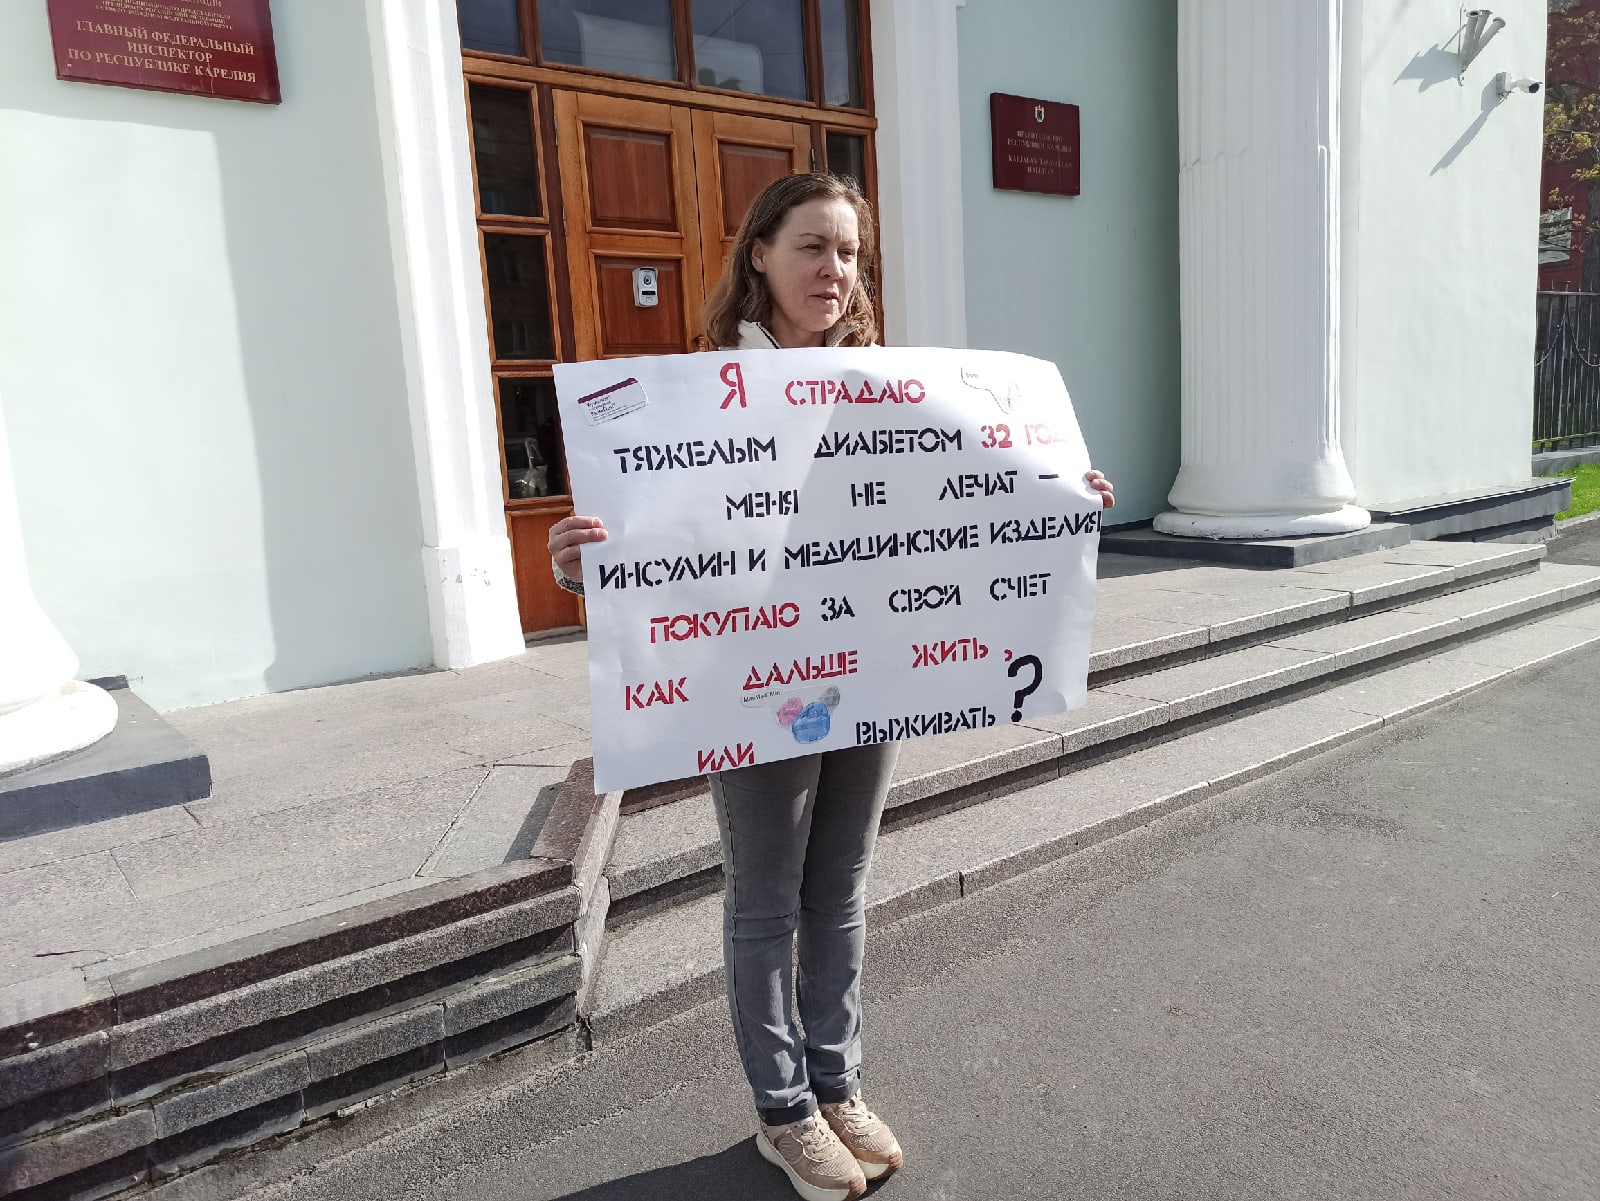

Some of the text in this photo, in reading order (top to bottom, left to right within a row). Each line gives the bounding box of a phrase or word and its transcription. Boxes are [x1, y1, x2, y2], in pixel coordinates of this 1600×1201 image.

[76, 20, 254, 56] ГЛАВНЫЙ ФЕДЕРАЛЬНЫЙ
[127, 41, 213, 63] ИНСПЕКТОР
[68, 48, 256, 83] ПО РЕСПУБЛИКЕ КАРЕЛИЯ
[720, 362, 925, 409] Я СТРАДАЮ
[613, 436, 776, 473] ТЯЖЕЛЫМ
[814, 428, 962, 458] ДИАБЕТОМ
[978, 424, 1012, 451] 32
[726, 489, 799, 520] МЕНЯ
[851, 481, 886, 507] НЕ
[939, 470, 1017, 500] ЛЕЧАТ
[599, 511, 1101, 589] ИНСУЛИН И МЕДИЦИНСКИЕ ИЗДЕЛИЯ
[651, 573, 1051, 643] ПОКУПАЮ ЗА СВОЙ СЧЕТ
[626, 677, 689, 710] КАК
[743, 650, 857, 690] ДАЛЬШЕ
[912, 637, 988, 668] ЖИТЬ
[697, 742, 755, 774] ИЛИ
[855, 706, 996, 745] ВЫЖИВАТЬ
